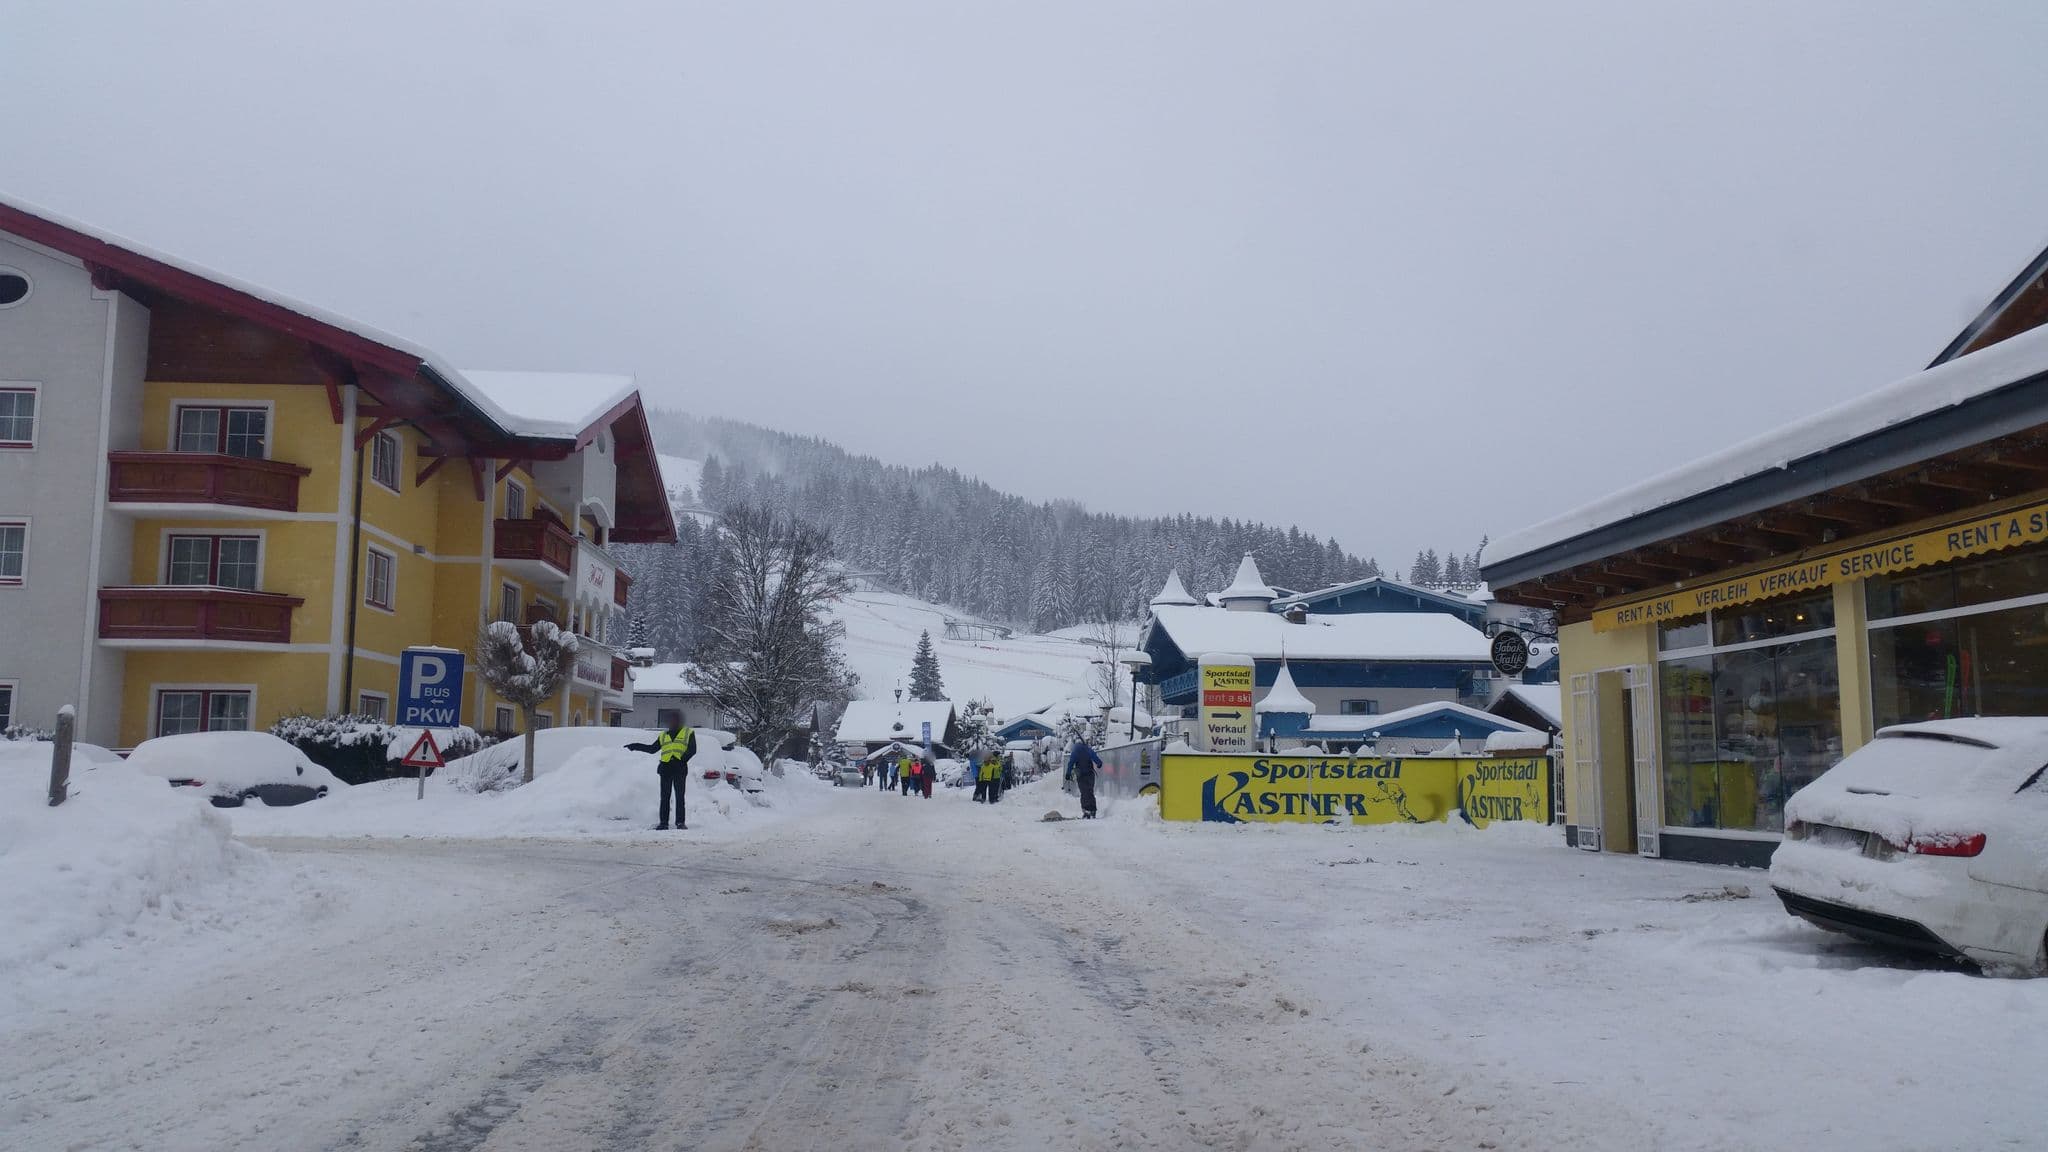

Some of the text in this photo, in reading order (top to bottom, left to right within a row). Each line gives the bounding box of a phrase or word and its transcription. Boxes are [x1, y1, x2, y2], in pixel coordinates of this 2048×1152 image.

[1617, 607, 1643, 625] RENT
[1646, 606, 1653, 618] A
[1656, 600, 1674, 616] SKI
[1695, 582, 1748, 607] VERLEIH
[1759, 564, 1828, 593] VERKAUF
[1841, 544, 1914, 576] SERVICE
[1947, 522, 2001, 551] RENT
[2008, 519, 2022, 539] A
[1495, 637, 1525, 653] Tabak
[410, 655, 447, 699] P
[1205, 669, 1251, 679] Sportstadl
[1213, 678, 1250, 688] KASTNER
[424, 687, 450, 698] BUS
[1205, 694, 1226, 702] rent
[1237, 693, 1251, 703] ski
[406, 707, 455, 724] PKW
[1208, 724, 1247, 734] Verkauf
[1211, 736, 1246, 746] Verleih
[1251, 759, 1402, 784] Sportstadl
[1475, 760, 1538, 787] Sportstadl
[1202, 771, 1369, 823] KASTNER
[1458, 774, 1523, 830] KASTNER
